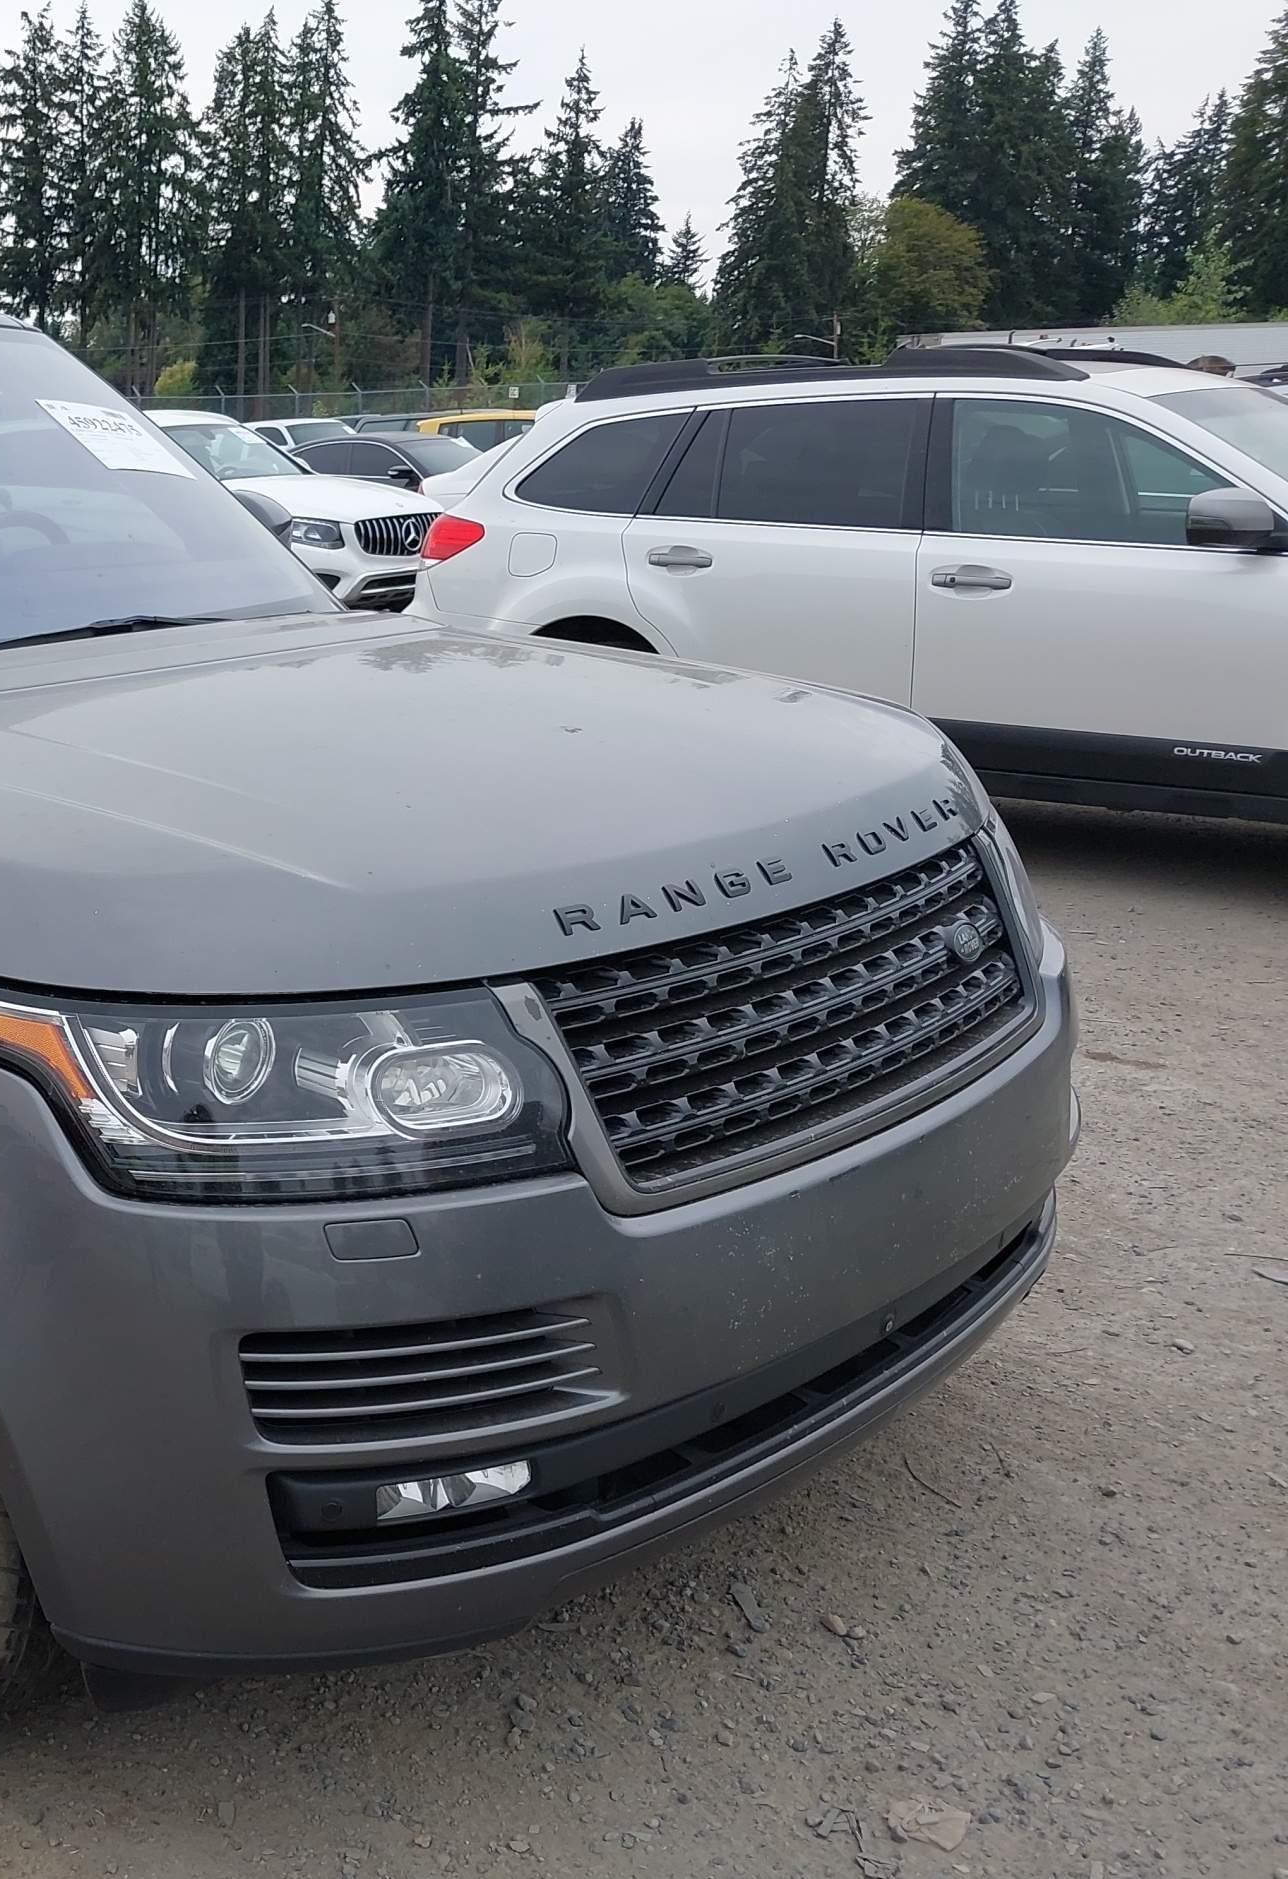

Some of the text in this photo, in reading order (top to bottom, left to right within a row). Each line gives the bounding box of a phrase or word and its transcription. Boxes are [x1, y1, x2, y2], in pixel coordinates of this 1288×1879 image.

[1173, 746, 1264, 764] OUTBACK
[552, 796, 960, 937] RANGE ROVER
